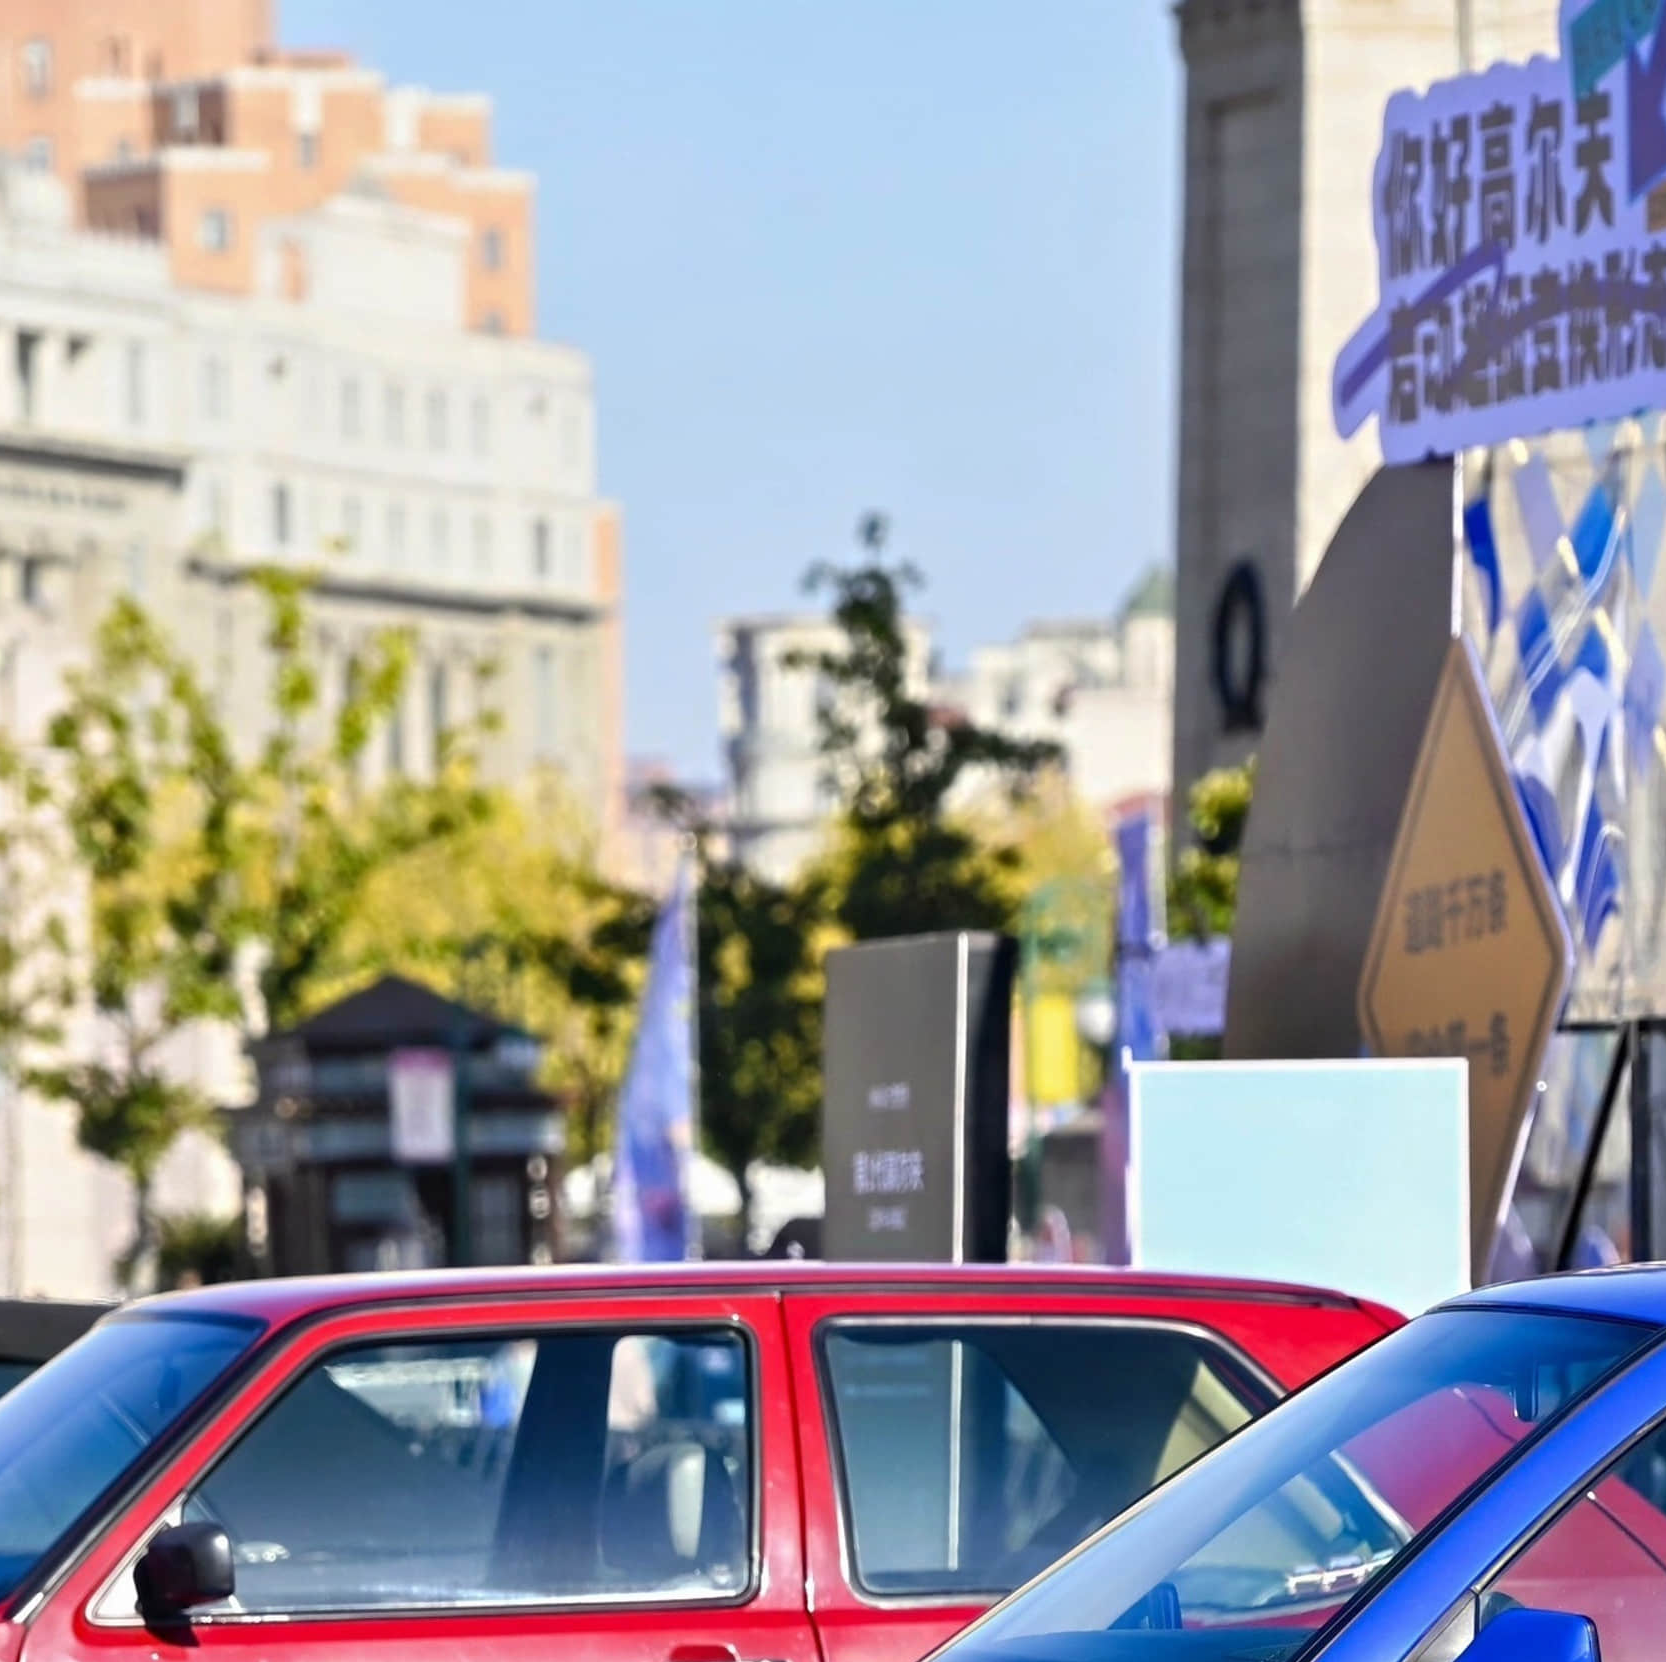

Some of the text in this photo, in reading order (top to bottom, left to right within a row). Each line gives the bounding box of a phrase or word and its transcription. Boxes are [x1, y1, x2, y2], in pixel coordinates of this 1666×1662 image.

[1384, 90, 1615, 279] 你好高尔夫
